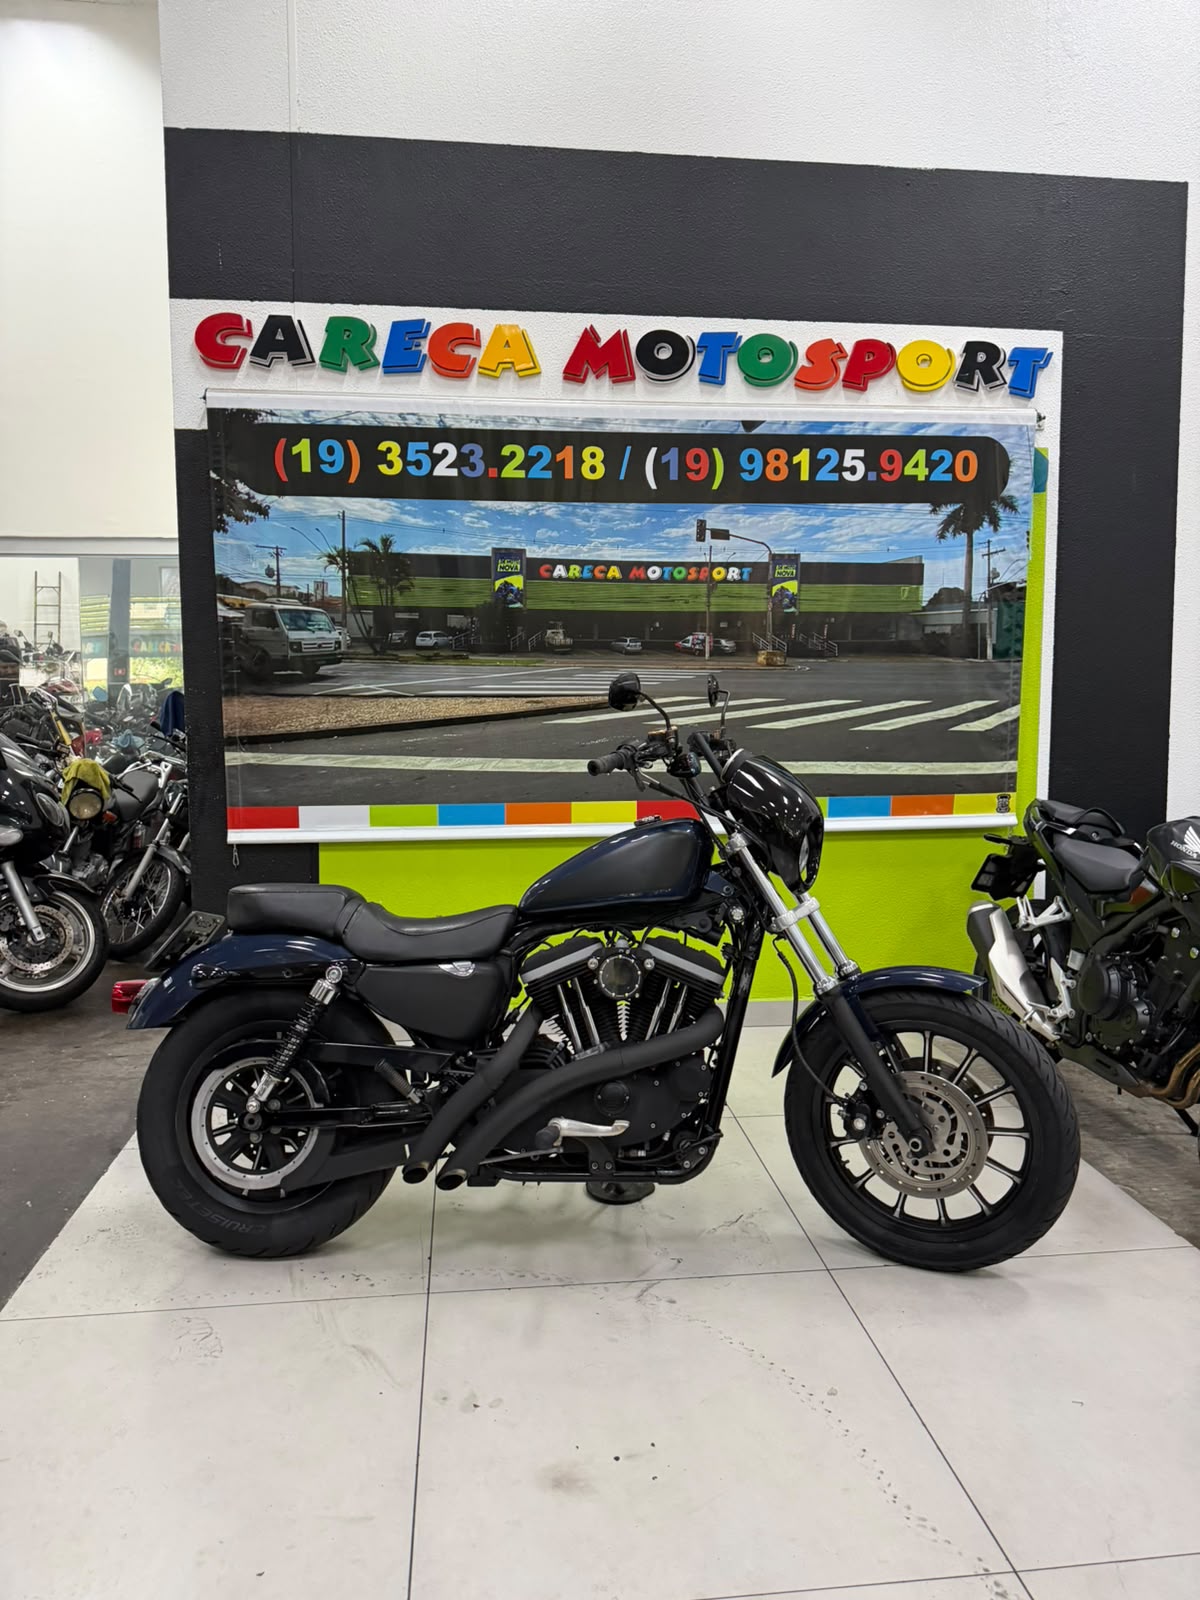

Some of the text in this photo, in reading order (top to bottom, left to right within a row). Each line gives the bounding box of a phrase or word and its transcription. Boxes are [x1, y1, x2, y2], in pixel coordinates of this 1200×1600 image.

[194, 312, 1053, 399] CARECA MOTOSPORT
[274, 437, 979, 490] (19) 3523.2218 / (19) 98125.9420
[539, 564, 753, 582] CARECA MOTOSPORT
[1170, 840, 1198, 859] HONDA
